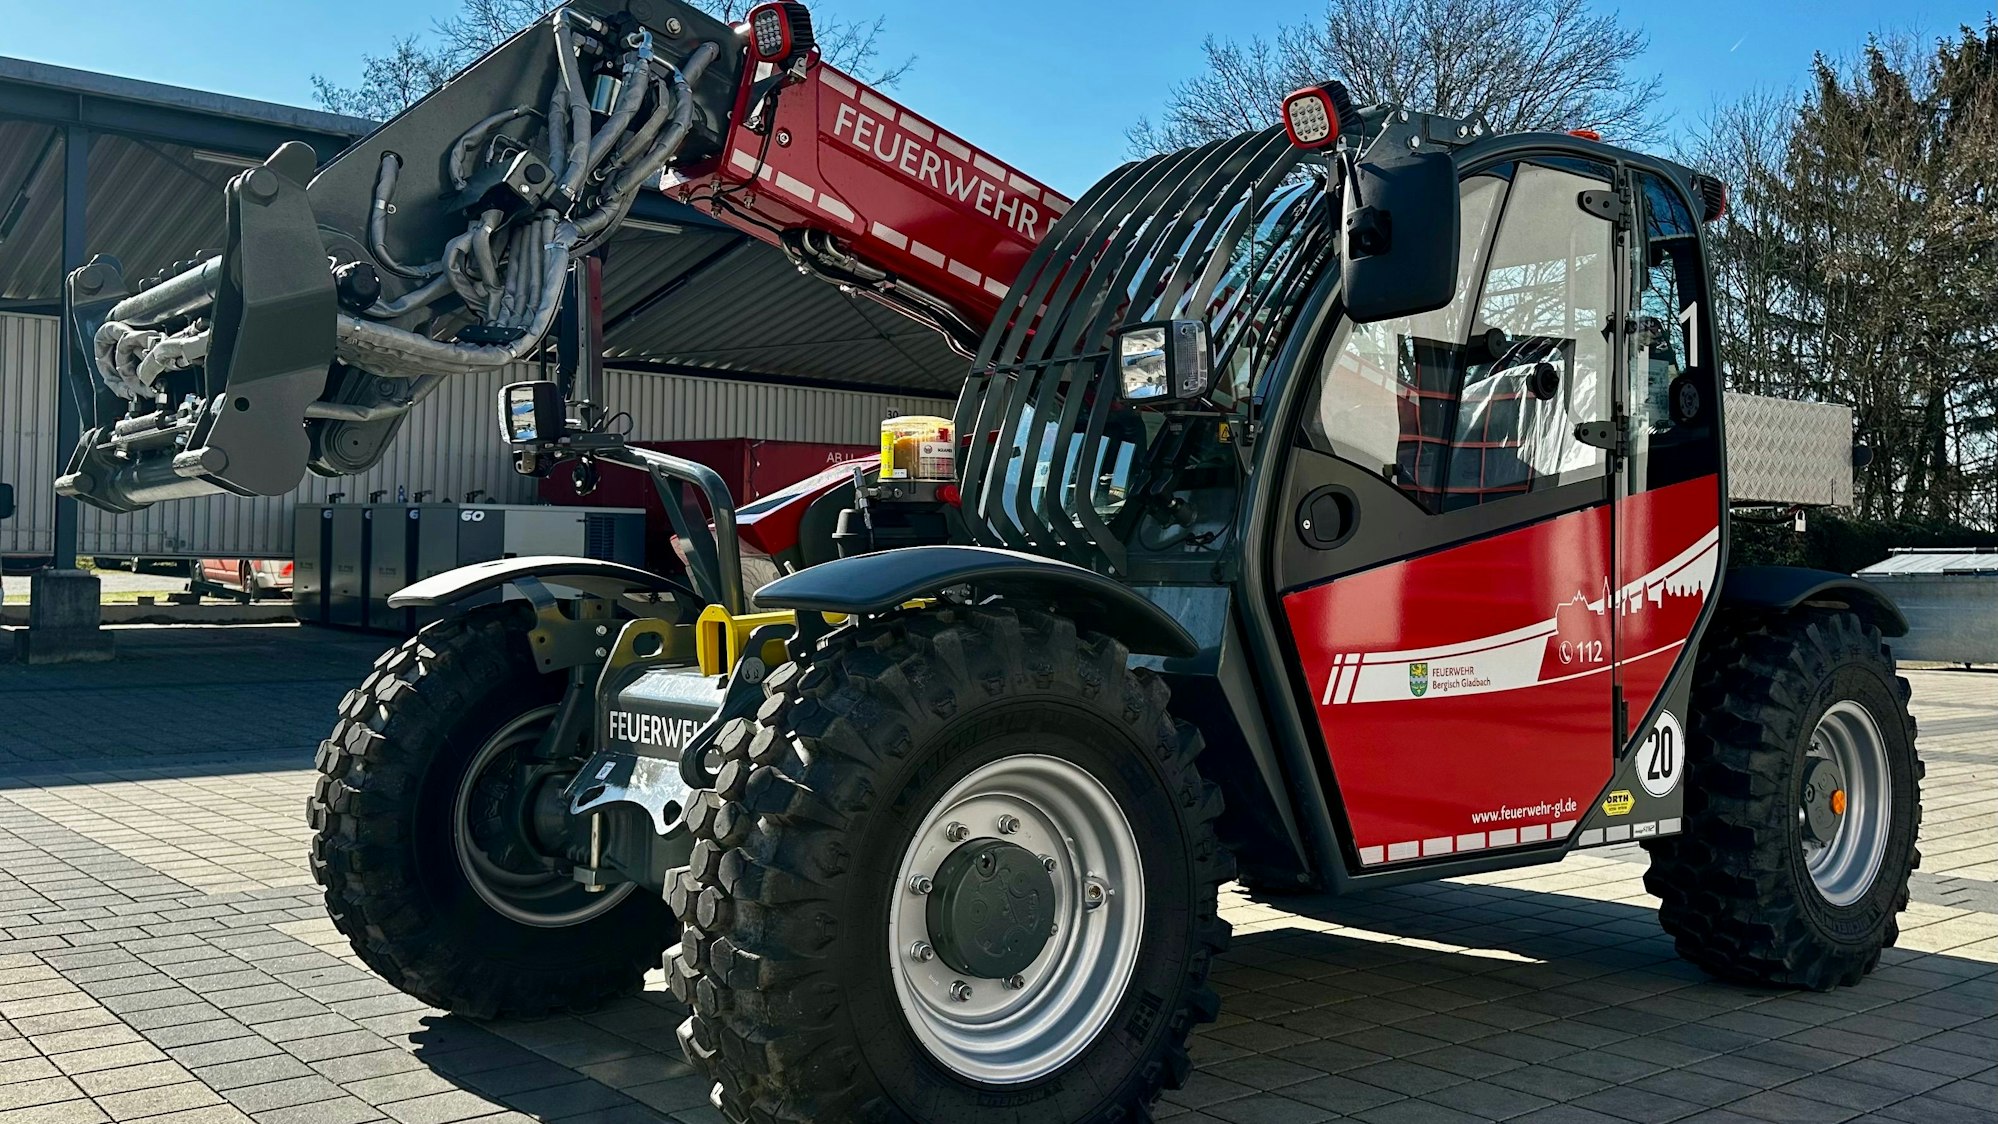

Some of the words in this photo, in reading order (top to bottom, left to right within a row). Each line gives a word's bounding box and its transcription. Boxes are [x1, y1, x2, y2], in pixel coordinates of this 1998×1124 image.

[833, 102, 1039, 240] FEUERWEHR
[1679, 300, 1698, 367] 1
[461, 510, 485, 521] 60
[1576, 640, 1604, 663] 112
[1432, 666, 1475, 677] FEUERWEHR
[1432, 679, 1460, 692] Bergisch
[1461, 676, 1491, 688] Gladbach
[1647, 725, 1673, 781] 20
[1471, 797, 1577, 824] www.feuerwehr-gl.de
